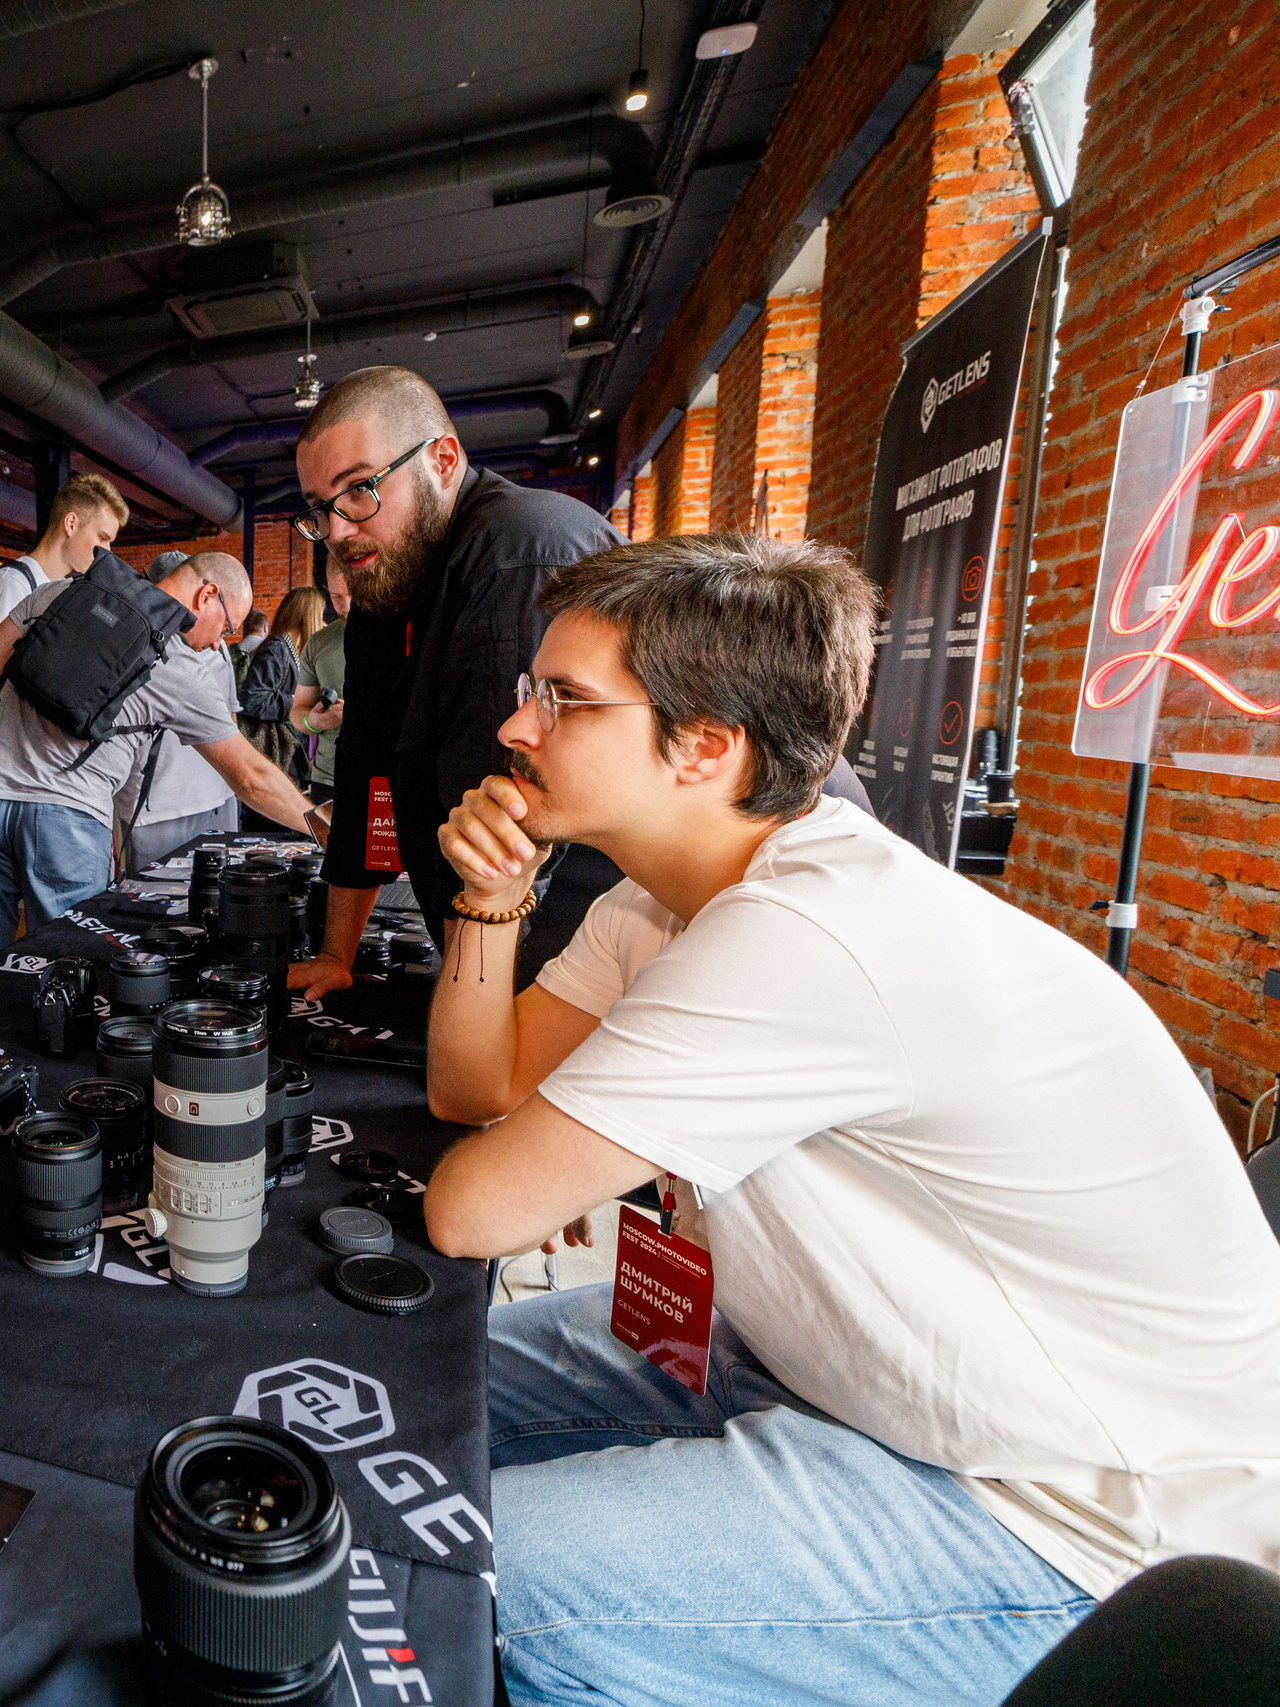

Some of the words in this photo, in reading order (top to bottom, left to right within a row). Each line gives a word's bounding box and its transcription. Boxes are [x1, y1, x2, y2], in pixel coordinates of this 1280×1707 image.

[937, 350, 992, 406] GETLENS
[939, 438, 1003, 490] ФОТОГРАФОВ
[920, 489, 975, 532] ФОТОГРАФОВ
[1084, 388, 1280, 715] Ge
[372, 830, 398, 838] РОЖД
[23, 955, 40, 970] GL
[74, 1246, 90, 1257] DEMO
[622, 1230, 640, 1245] FEST
[639, 1240, 658, 1256] 2024
[622, 1222, 708, 1276] MOSCOW.PHOTOVIDEO
[617, 1299, 652, 1326] GETLENS
[620, 1260, 693, 1315] ДМИТРИЙ
[620, 1274, 685, 1325] ШУМКОВ
[294, 1386, 342, 1426] GL
[357, 1450, 493, 1557] GE
[347, 1549, 434, 1707] FUJIF
